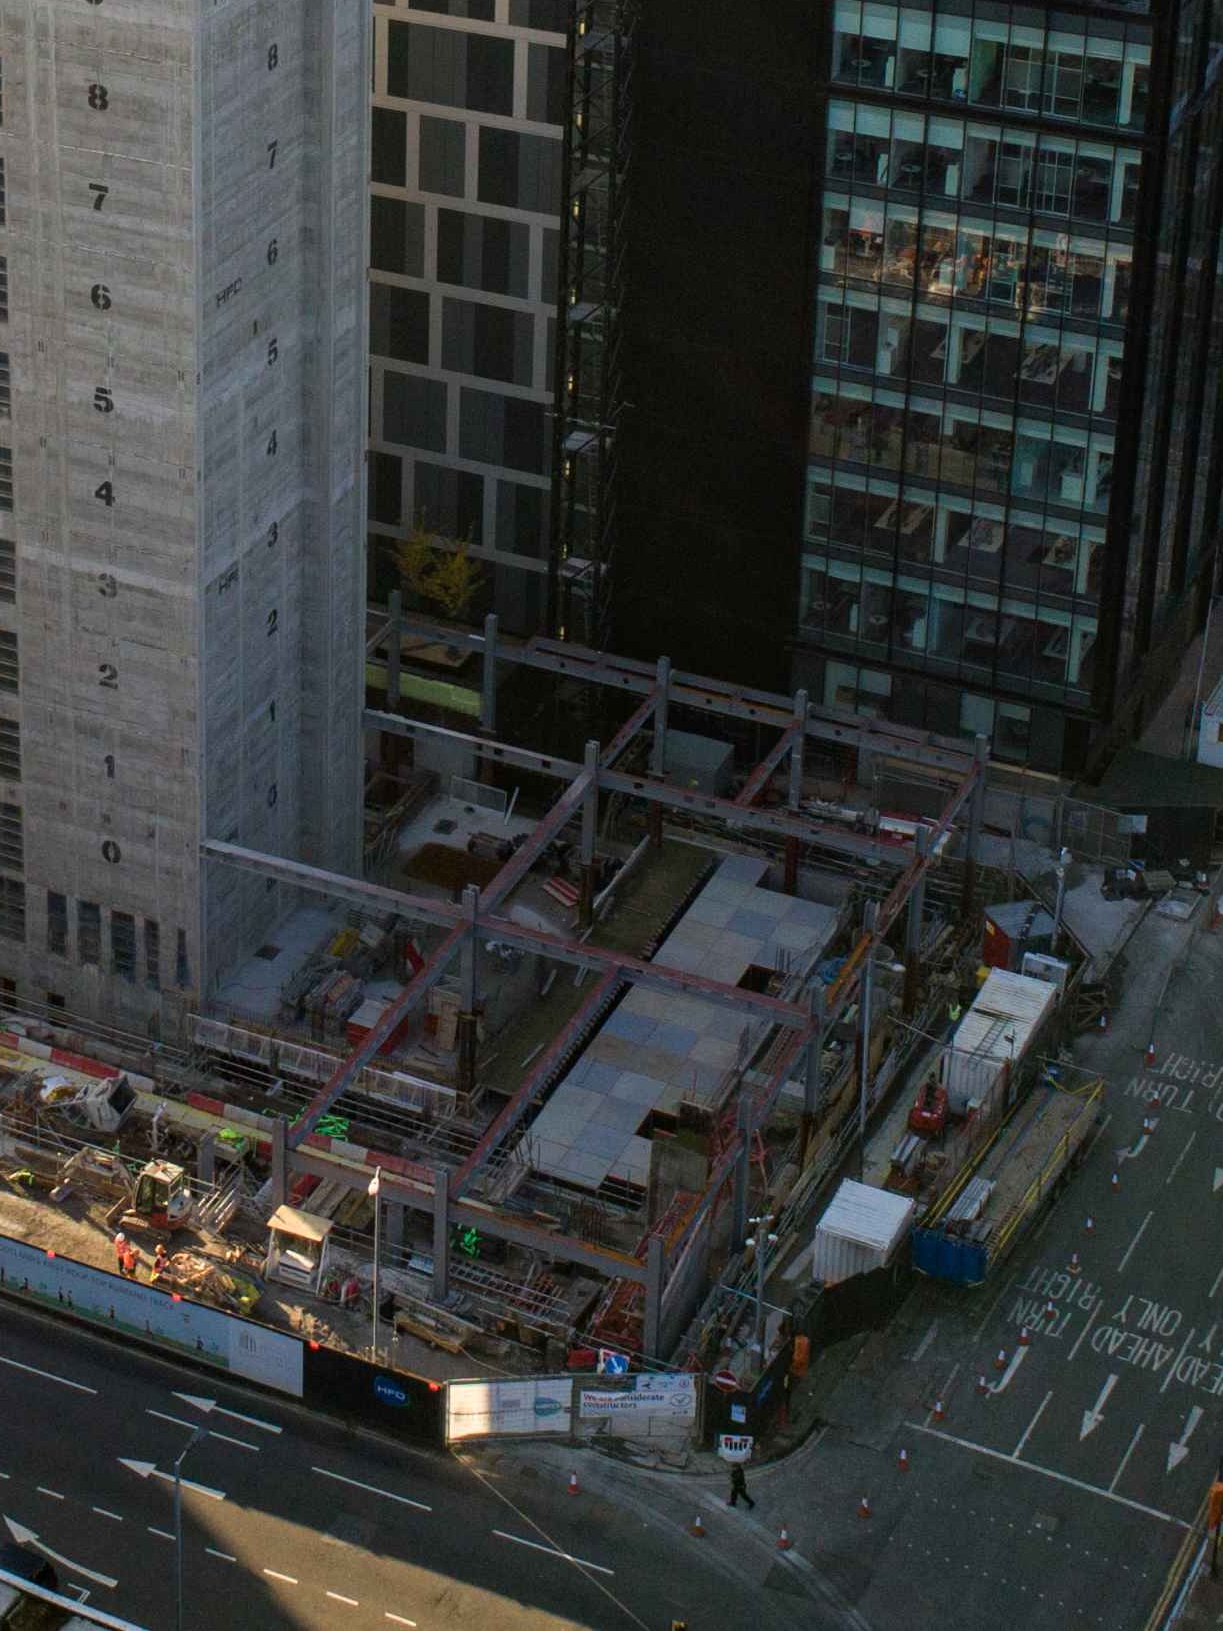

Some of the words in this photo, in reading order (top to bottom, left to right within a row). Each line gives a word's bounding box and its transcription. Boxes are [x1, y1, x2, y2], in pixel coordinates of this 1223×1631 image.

[268, 44, 278, 72] 8
[88, 83, 108, 110] 8
[268, 139, 278, 169] 7
[89, 183, 109, 210] 7
[267, 239, 278, 266] 6
[91, 284, 111, 310] 6
[268, 338, 277, 366] 5
[93, 386, 114, 413] 5
[267, 429, 277, 456] 4
[94, 480, 115, 507] 4
[98, 573, 117, 598] 3
[268, 609, 277, 637] 2
[98, 663, 118, 689] 2
[104, 755, 115, 779] 1
[268, 783, 276, 808] 0
[101, 840, 121, 864] 0
[1124, 1077, 1195, 1113] TURN
[1016, 1265, 1102, 1310] RIGHT
[1007, 1296, 1073, 1338] TURN
[1112, 1294, 1183, 1336] ONLY
[1091, 1326, 1175, 1372] AHEAD
[376, 1384, 406, 1401] HFD
